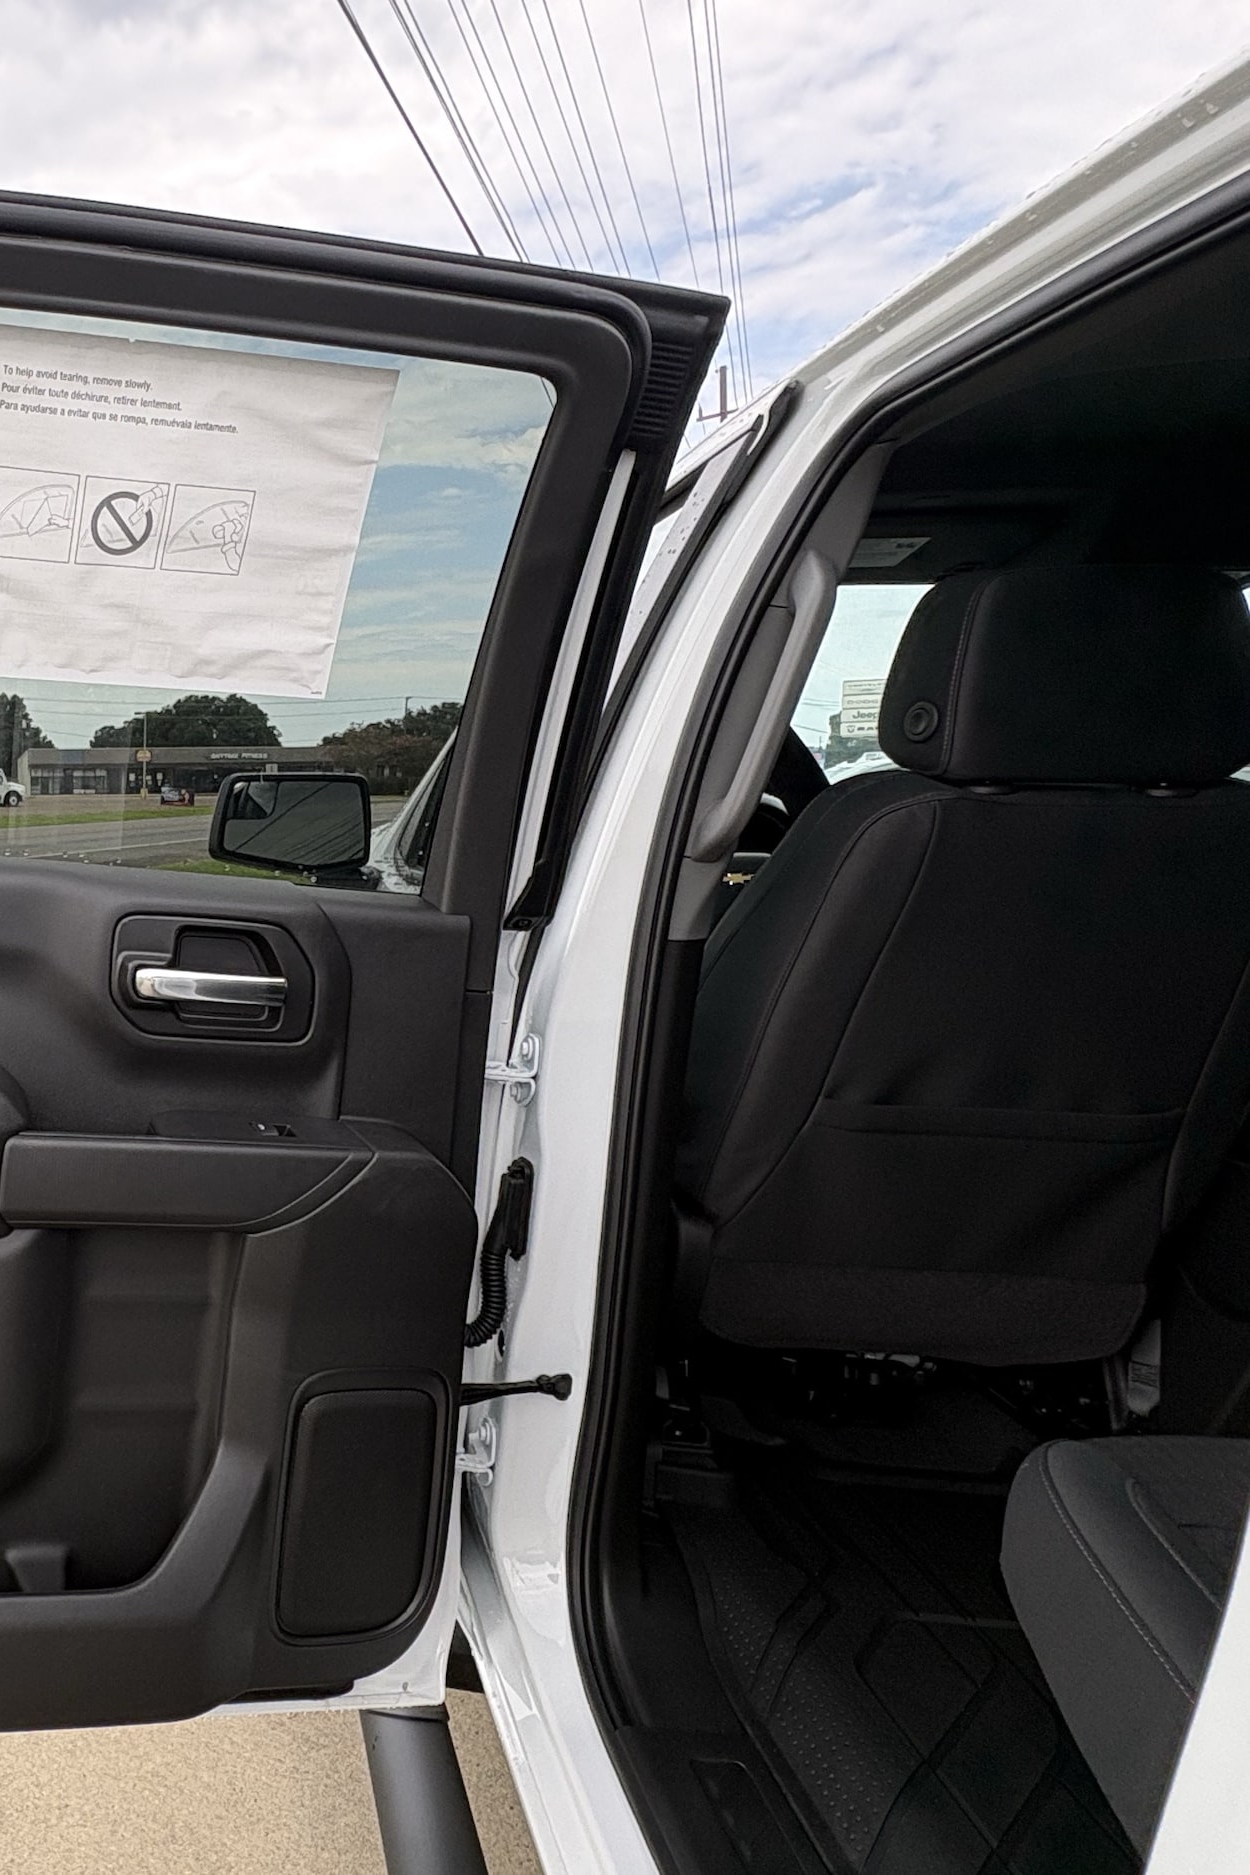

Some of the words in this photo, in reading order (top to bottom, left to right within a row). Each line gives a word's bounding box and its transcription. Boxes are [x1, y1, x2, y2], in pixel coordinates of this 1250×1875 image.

[3, 364, 13, 375] To
[15, 366, 34, 379] help
[36, 370, 58, 380] avoid
[60, 371, 90, 386] tearing,
[93, 376, 122, 387] remove
[125, 379, 153, 392] slowly.
[1, 382, 20, 393] Pour
[22, 384, 46, 396] éviter
[49, 388, 69, 399] toute
[71, 390, 111, 405] déchirure,
[113, 395, 138, 407] retirer
[140, 397, 182, 411] lentement.
[0, 399, 18, 411] Para
[20, 402, 58, 416] ayudarse
[60, 408, 65, 416] a
[67, 408, 90, 418] evitar
[91, 412, 107, 422] que
[109, 413, 118, 421] se
[120, 414, 148, 426] rompa,
[150, 417, 192, 430] remuévala
[194, 420, 238, 434] lentamente.
